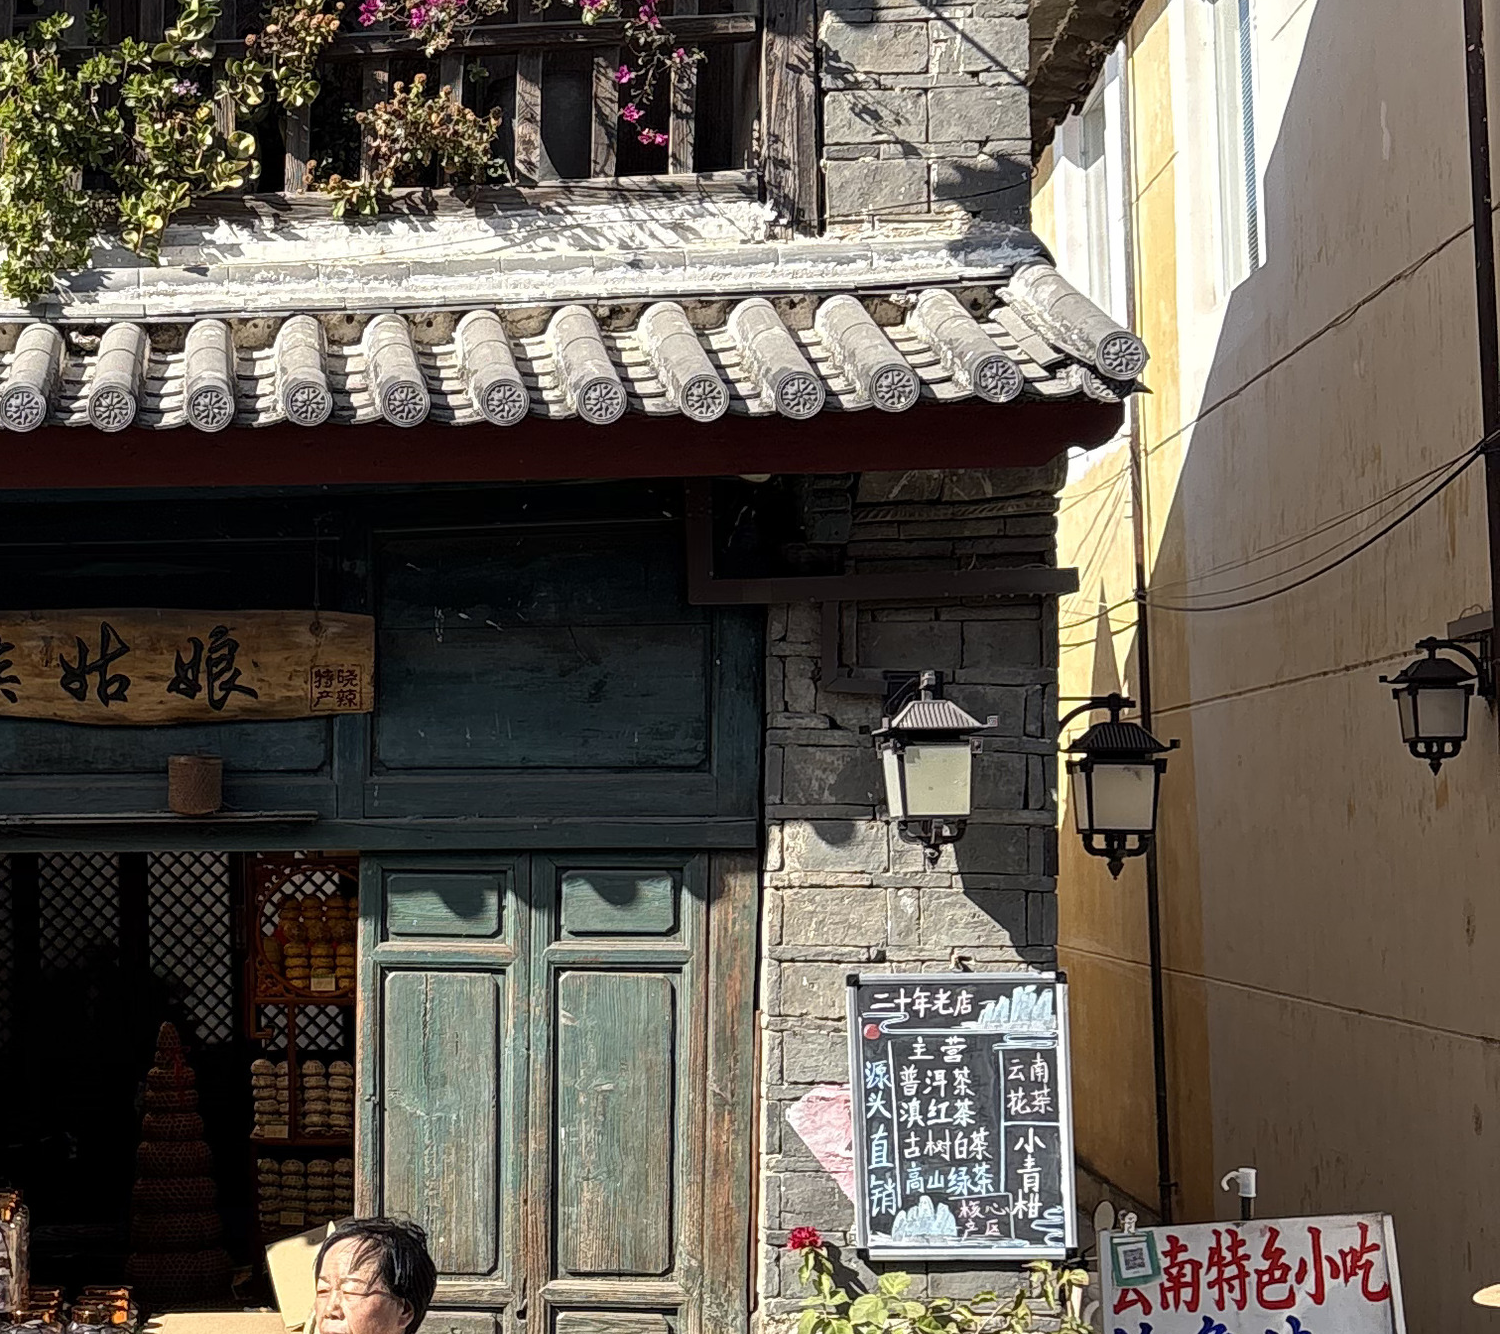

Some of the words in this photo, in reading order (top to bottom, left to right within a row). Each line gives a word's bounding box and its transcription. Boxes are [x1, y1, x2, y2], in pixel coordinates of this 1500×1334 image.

[870, 988, 974, 1017] 二十年老店
[908, 1036, 967, 1063] 主营
[899, 1066, 975, 1096] 普洱茶
[1006, 1052, 1049, 1083] 云南
[899, 1099, 976, 1128] 滇红茶
[1006, 1089, 1054, 1115] 花茶
[865, 1060, 898, 1217] 源头直销
[903, 1127, 992, 1161] 古树白茶
[905, 1162, 995, 1196] 高山绿茶
[1014, 1127, 1046, 1219] 小青柑
[959, 1199, 1007, 1219] 核心
[960, 1220, 1002, 1241] 产区
